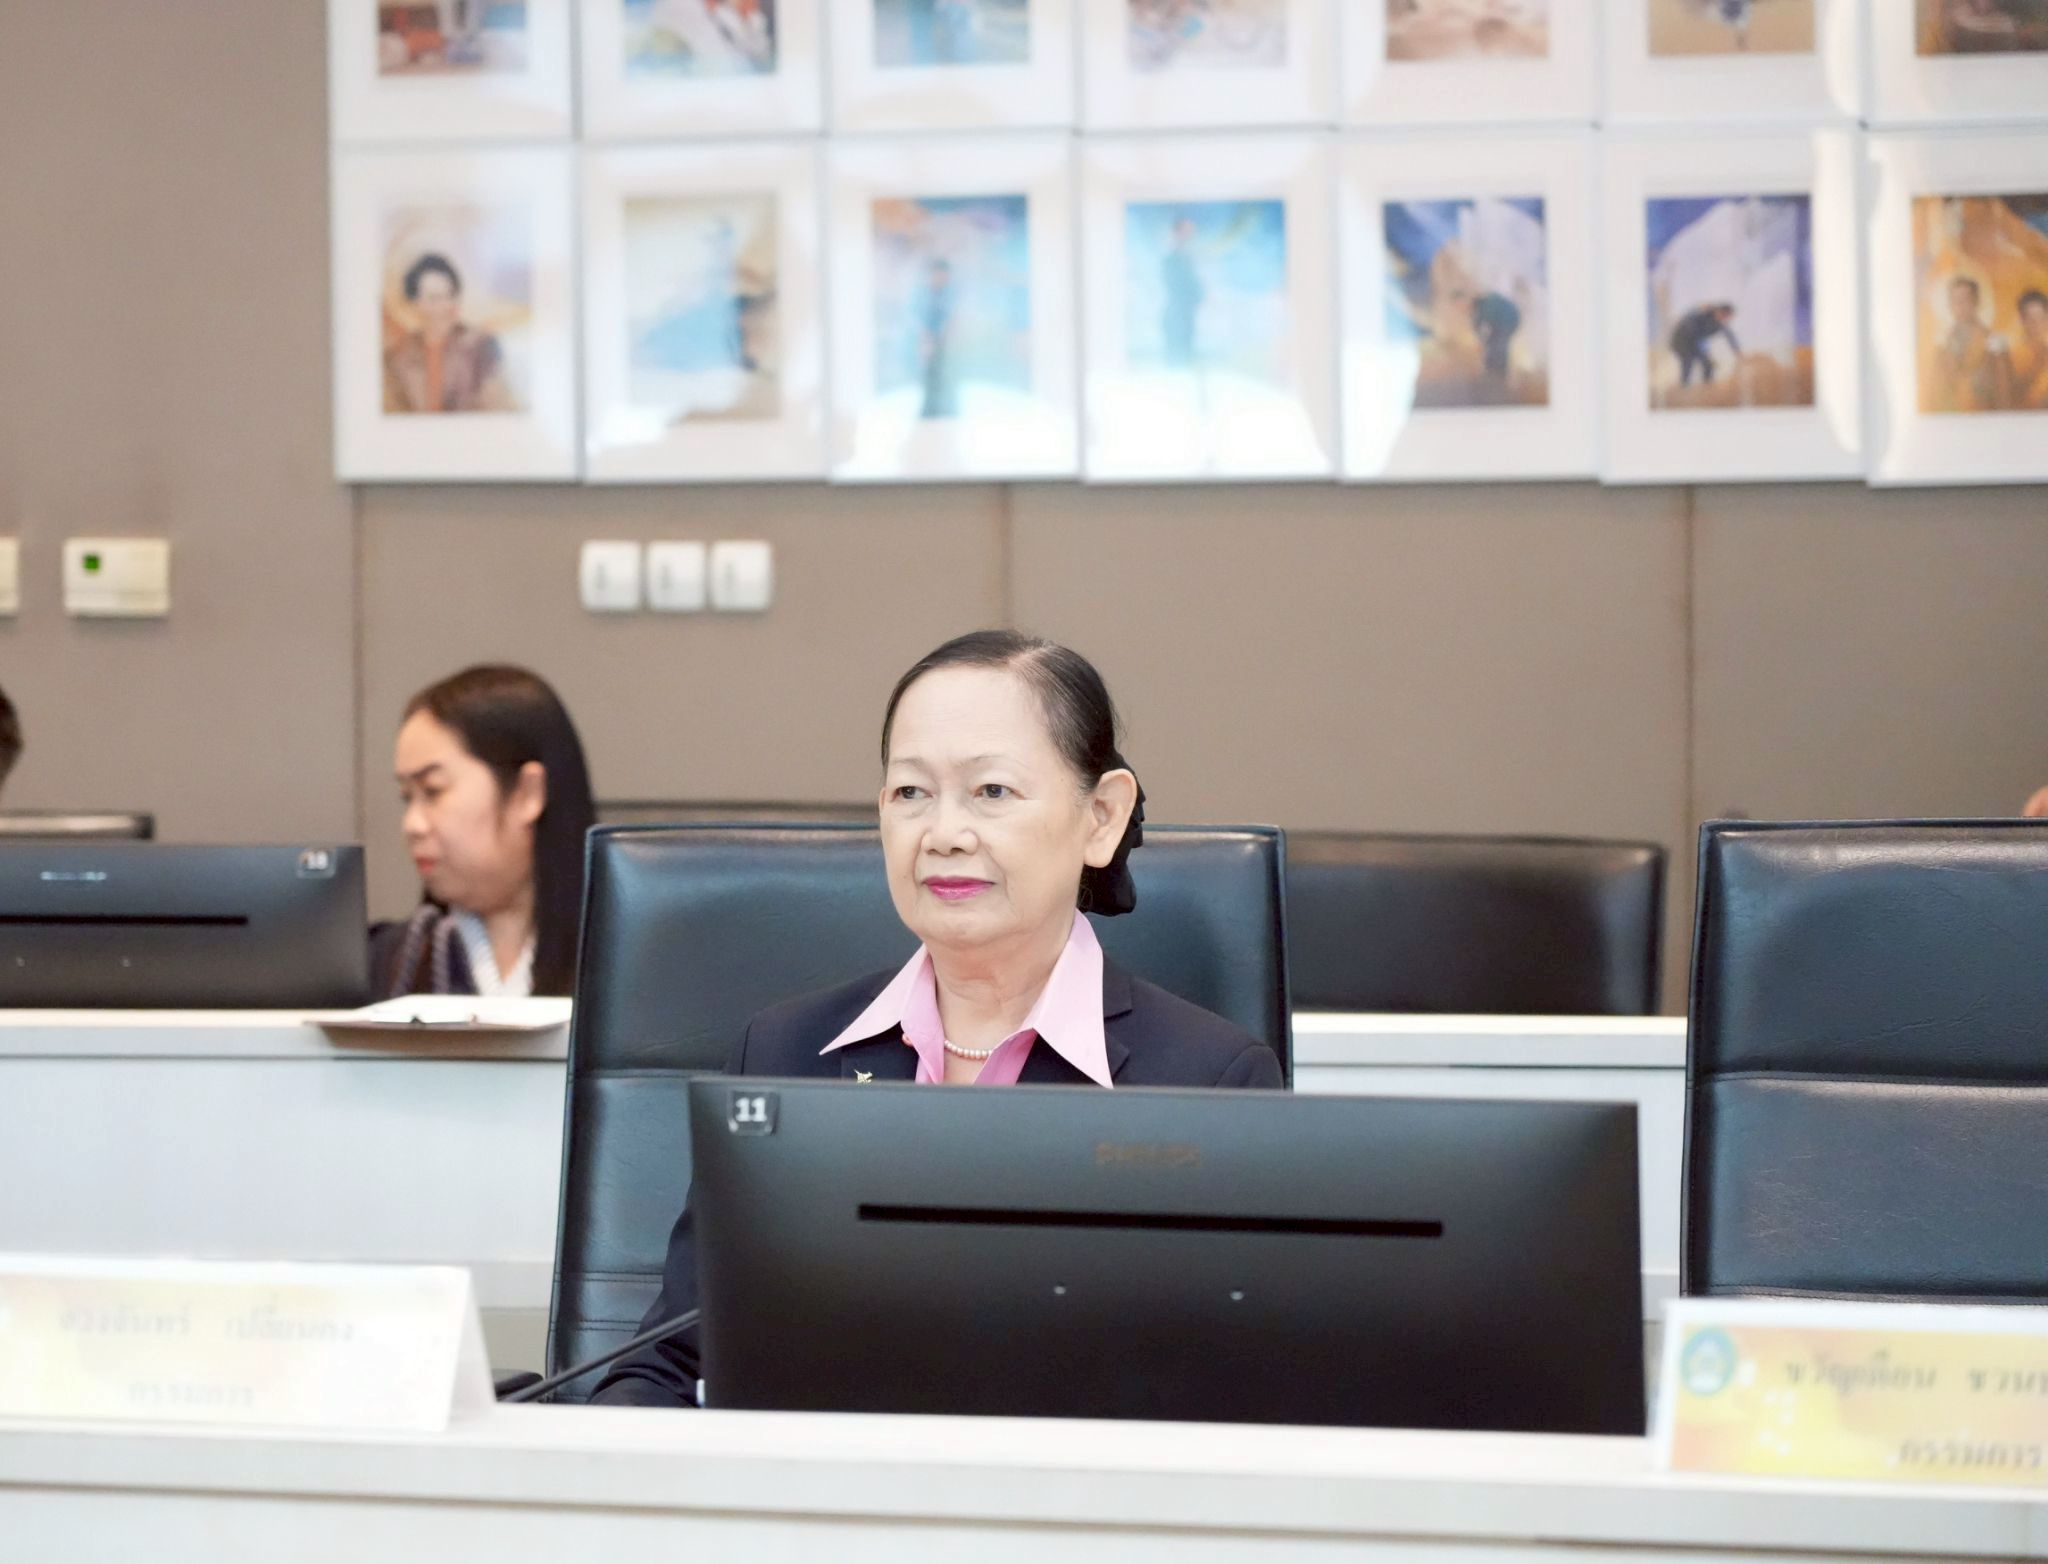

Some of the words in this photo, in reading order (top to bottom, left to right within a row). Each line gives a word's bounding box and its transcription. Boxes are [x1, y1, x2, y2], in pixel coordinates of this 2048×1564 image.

[735, 1097, 767, 1122] 11
[1900, 1440, 2042, 1470] กรรมการ
